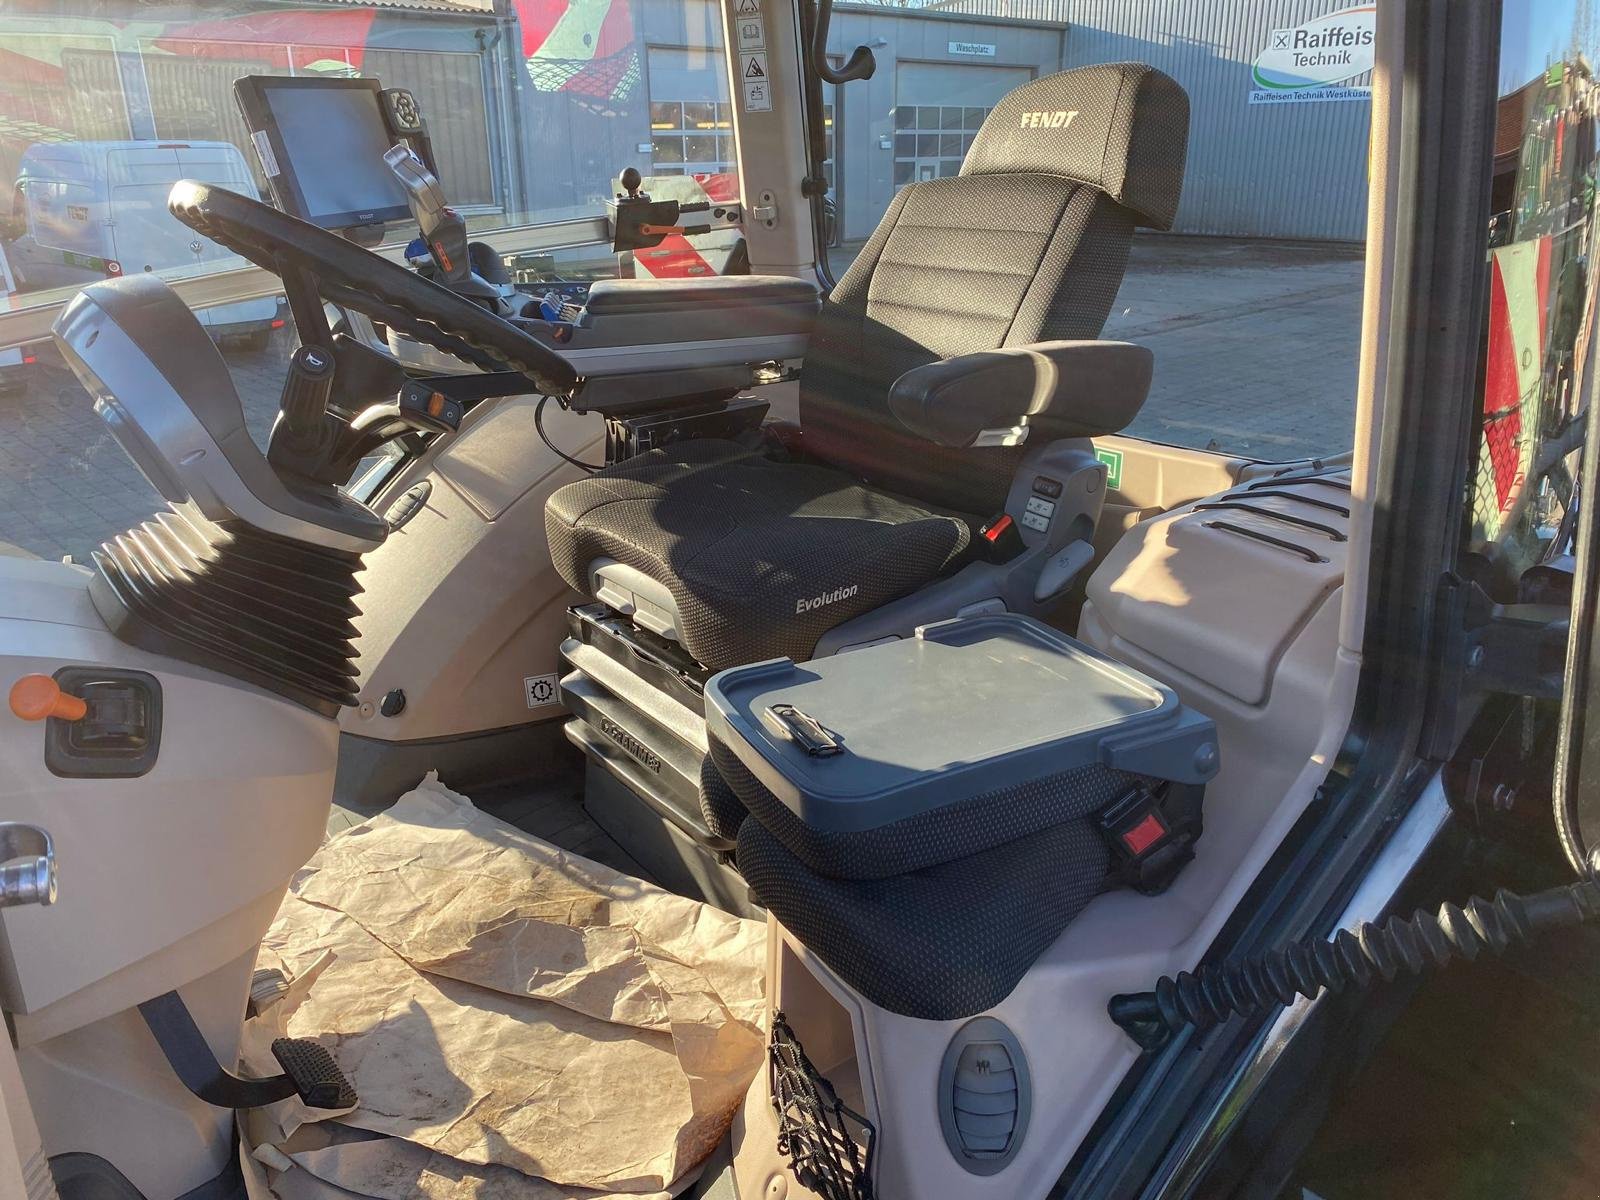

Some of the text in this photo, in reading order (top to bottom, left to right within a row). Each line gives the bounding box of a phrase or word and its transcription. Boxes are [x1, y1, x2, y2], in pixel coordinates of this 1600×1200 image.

[1293, 26, 1373, 49] Raiffeis
[956, 43, 989, 54] Waschplatz
[1293, 50, 1351, 67] Technik
[1253, 91, 1293, 101] Raiffeisen
[1294, 90, 1325, 100] Technik
[1020, 110, 1079, 129] FENDT
[796, 584, 858, 614] Evolution
